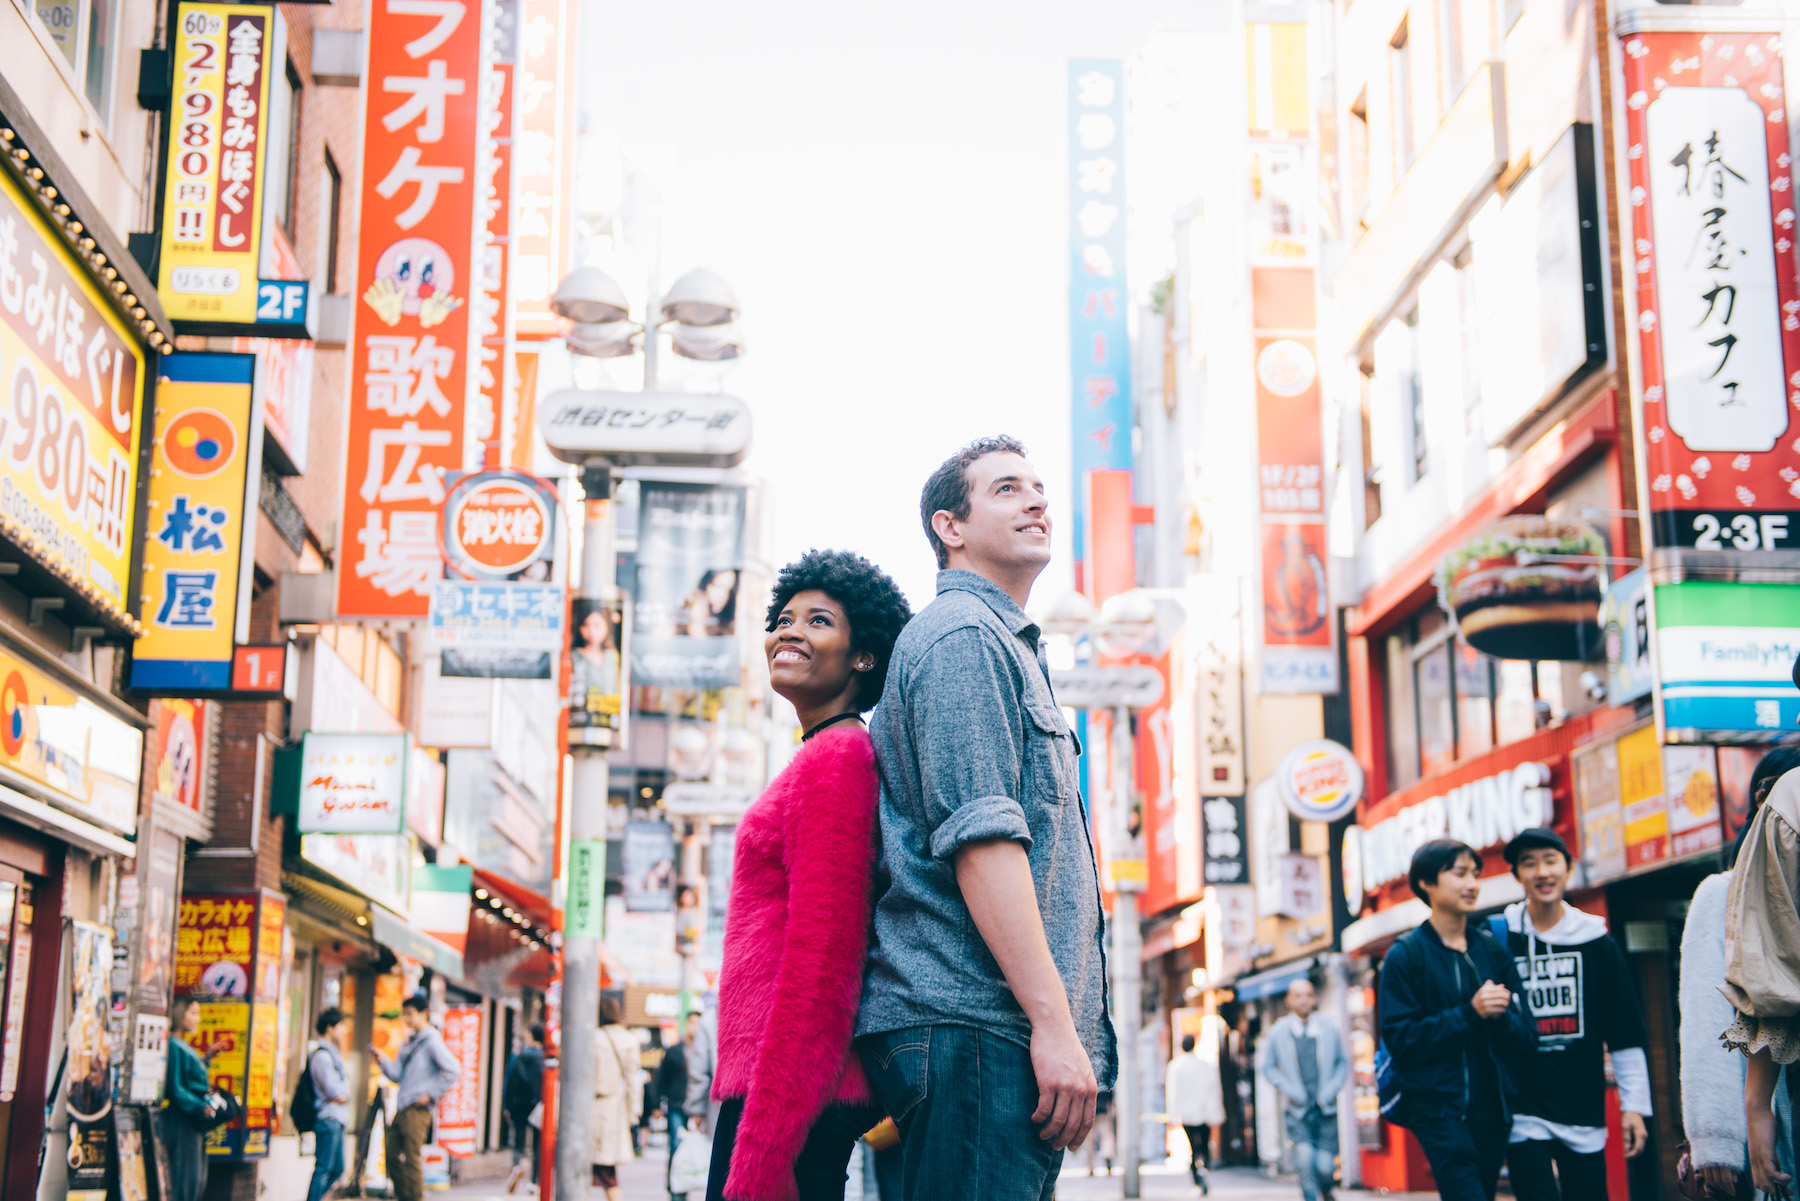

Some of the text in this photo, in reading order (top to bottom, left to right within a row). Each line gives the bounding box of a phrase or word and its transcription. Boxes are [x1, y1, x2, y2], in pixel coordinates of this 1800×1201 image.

[219, 20, 262, 247] 全身もみほぐし
[1670, 129, 1749, 407] 椿屋カフェ
[257, 285, 304, 320] 2F
[550, 404, 740, 431] 渋谷センター街
[462, 507, 541, 545] 消火栓
[153, 494, 228, 629] 松屋
[1448, 761, 1553, 851] KING
[180, 900, 254, 927] カラオケ
[1532, 985, 1572, 1009] OUR
